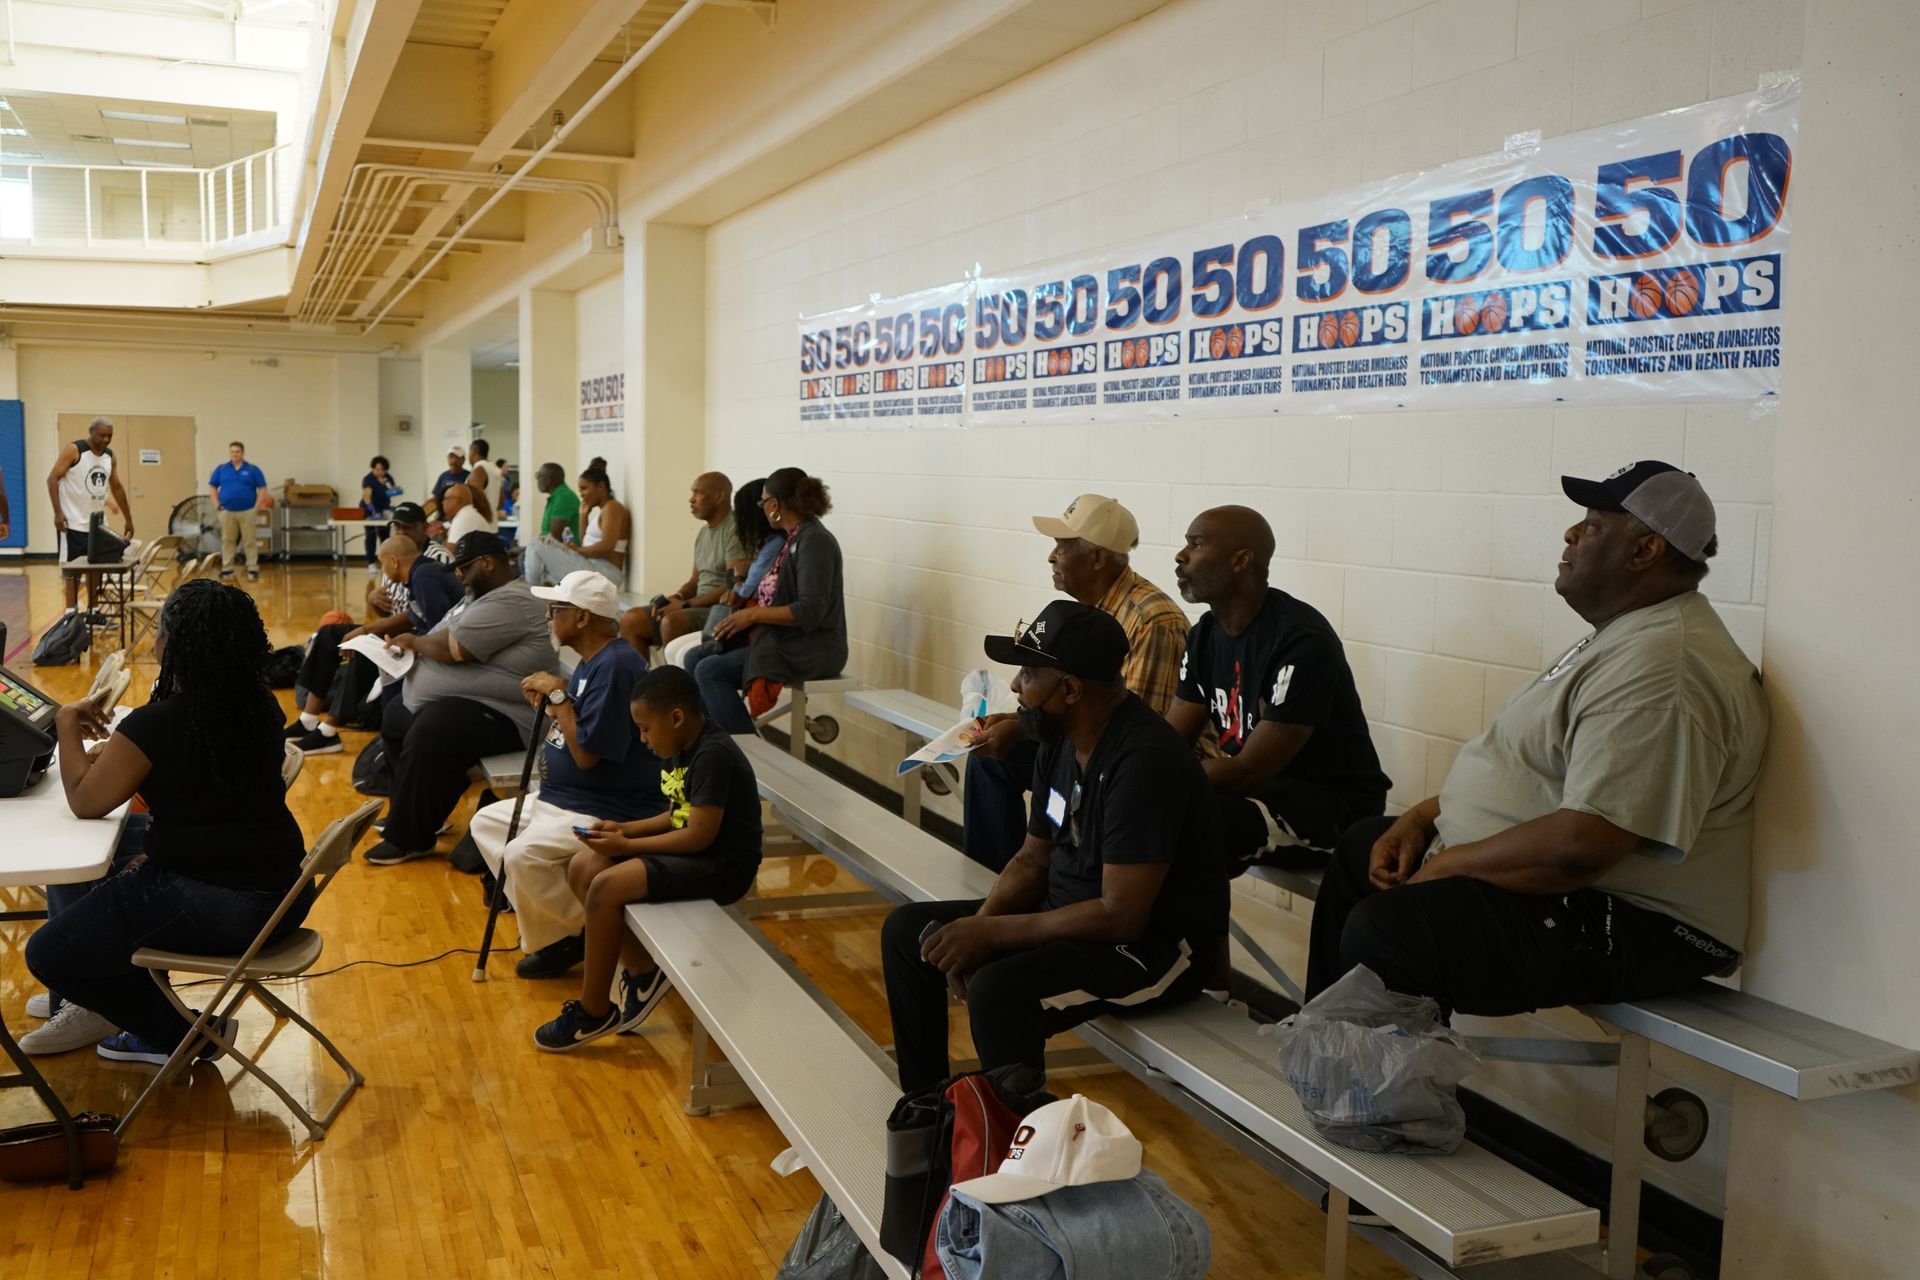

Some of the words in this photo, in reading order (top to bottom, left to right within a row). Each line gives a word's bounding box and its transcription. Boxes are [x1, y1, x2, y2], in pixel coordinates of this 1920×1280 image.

[1592, 132, 1792, 261] 50
[1425, 175, 1576, 284] 50
[1192, 234, 1284, 319] 50
[1296, 208, 1412, 303] 50
[1034, 274, 1098, 342] 50
[1105, 257, 1182, 331] 50
[875, 312, 914, 363] 50
[920, 303, 965, 358] 50
[975, 288, 1028, 350] 50
[1586, 339, 1626, 357] NATIONAL
[1629, 334, 1674, 354] PROSTATE
[1676, 331, 1714, 350] CANCER
[1716, 326, 1780, 349] AWARENESS
[801, 330, 832, 374] 50
[835, 321, 871, 369] 50
[1292, 363, 1317, 378] NATIONAL
[1318, 360, 1346, 376] PROSTATE
[1346, 358, 1370, 374] CANCER
[1371, 355, 1408, 372] AWARENESS
[1420, 351, 1452, 368] NATIONAL
[1454, 348, 1488, 366] PROSTATE
[1489, 346, 1519, 363] CANCER
[1520, 342, 1569, 361] AWARENESS
[1585, 355, 1666, 376] TOURNAMENTS
[1668, 353, 1692, 372] AND
[1695, 351, 1740, 371] HEALTH
[1743, 348, 1780, 368] FAIRS
[606, 374, 618, 402] 50
[1292, 377, 1340, 393] TOURNAMENTS
[1341, 376, 1356, 390] AND
[1358, 374, 1384, 388] HEALTH
[1385, 372, 1407, 387] FAIRS
[1420, 367, 1481, 385] TOURNAMENTS
[1483, 366, 1502, 382] AND
[1504, 363, 1538, 380] HEALTH
[1540, 361, 1568, 378] FAIRS
[1013, 1125, 1036, 1147] 0
